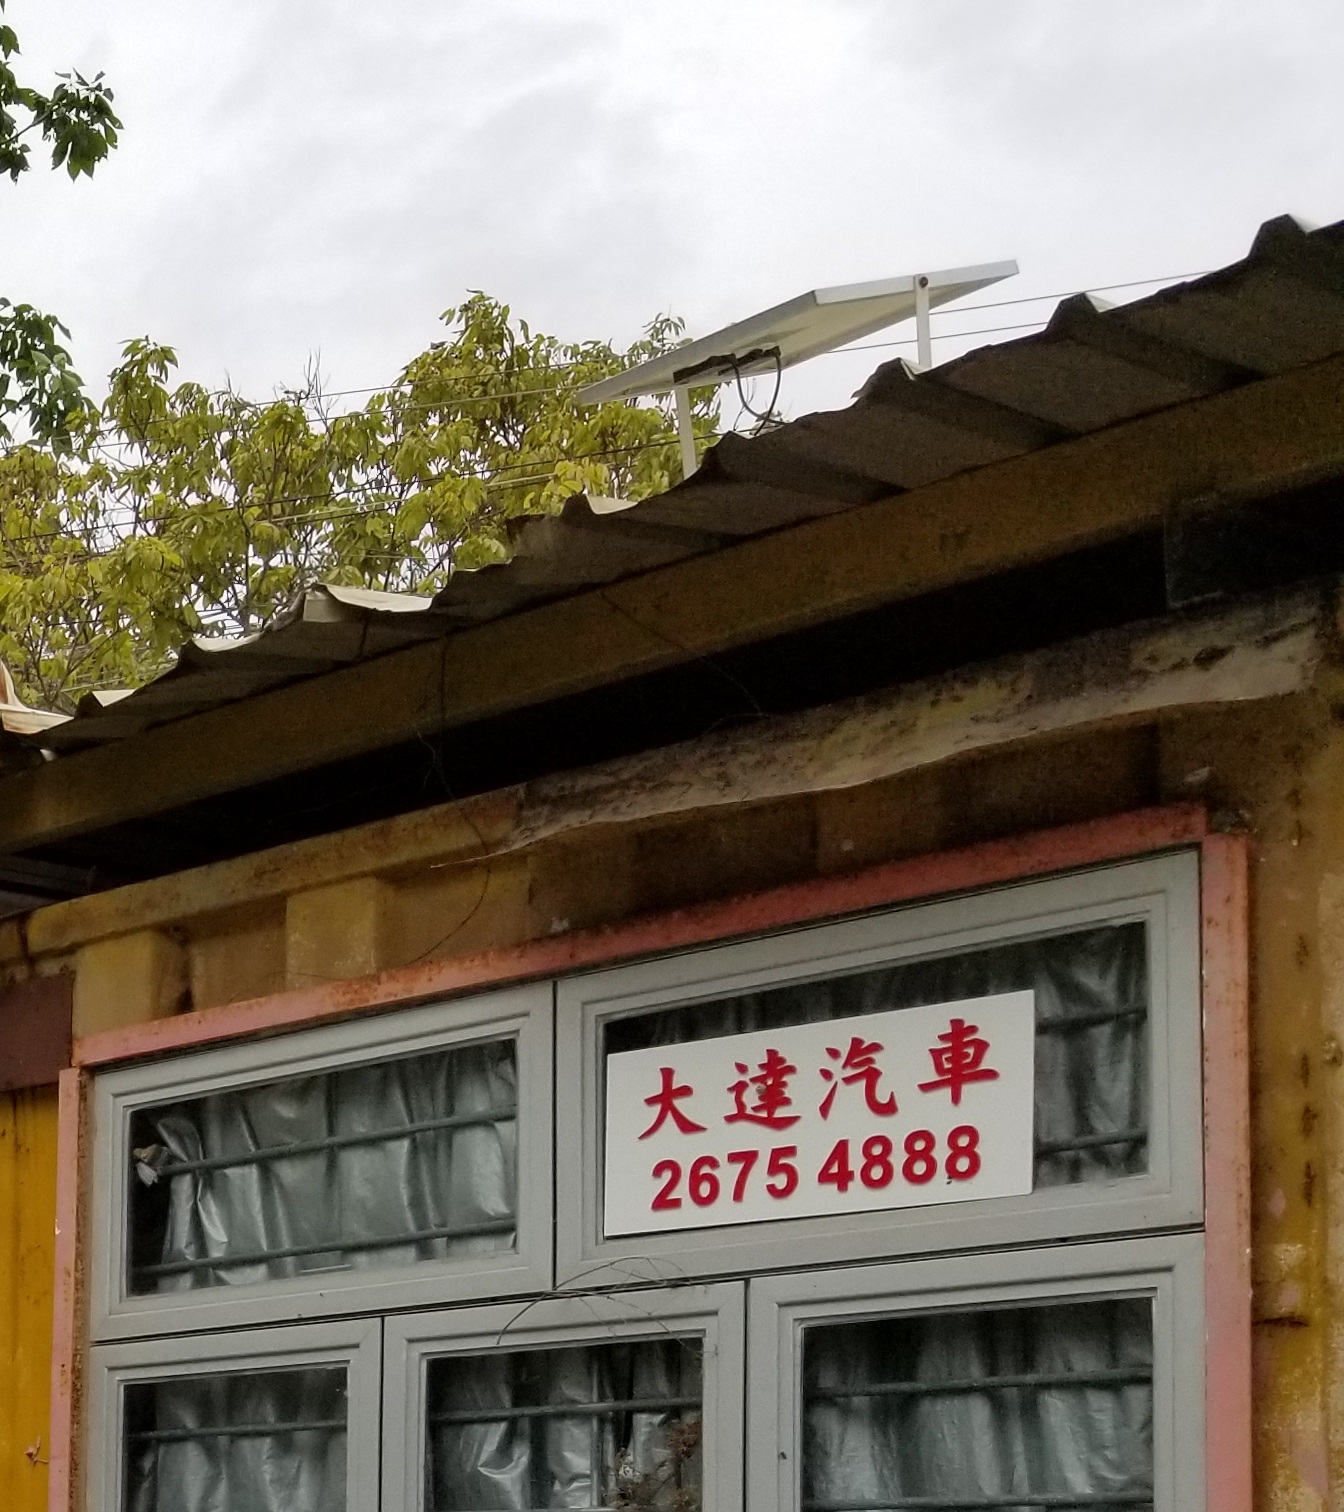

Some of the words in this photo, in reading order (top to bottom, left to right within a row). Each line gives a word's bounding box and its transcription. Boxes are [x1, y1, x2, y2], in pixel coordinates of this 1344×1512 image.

[638, 1018, 1000, 1140] 大達汽車
[651, 1145, 799, 1211] 2675
[817, 1125, 982, 1192] 4888
